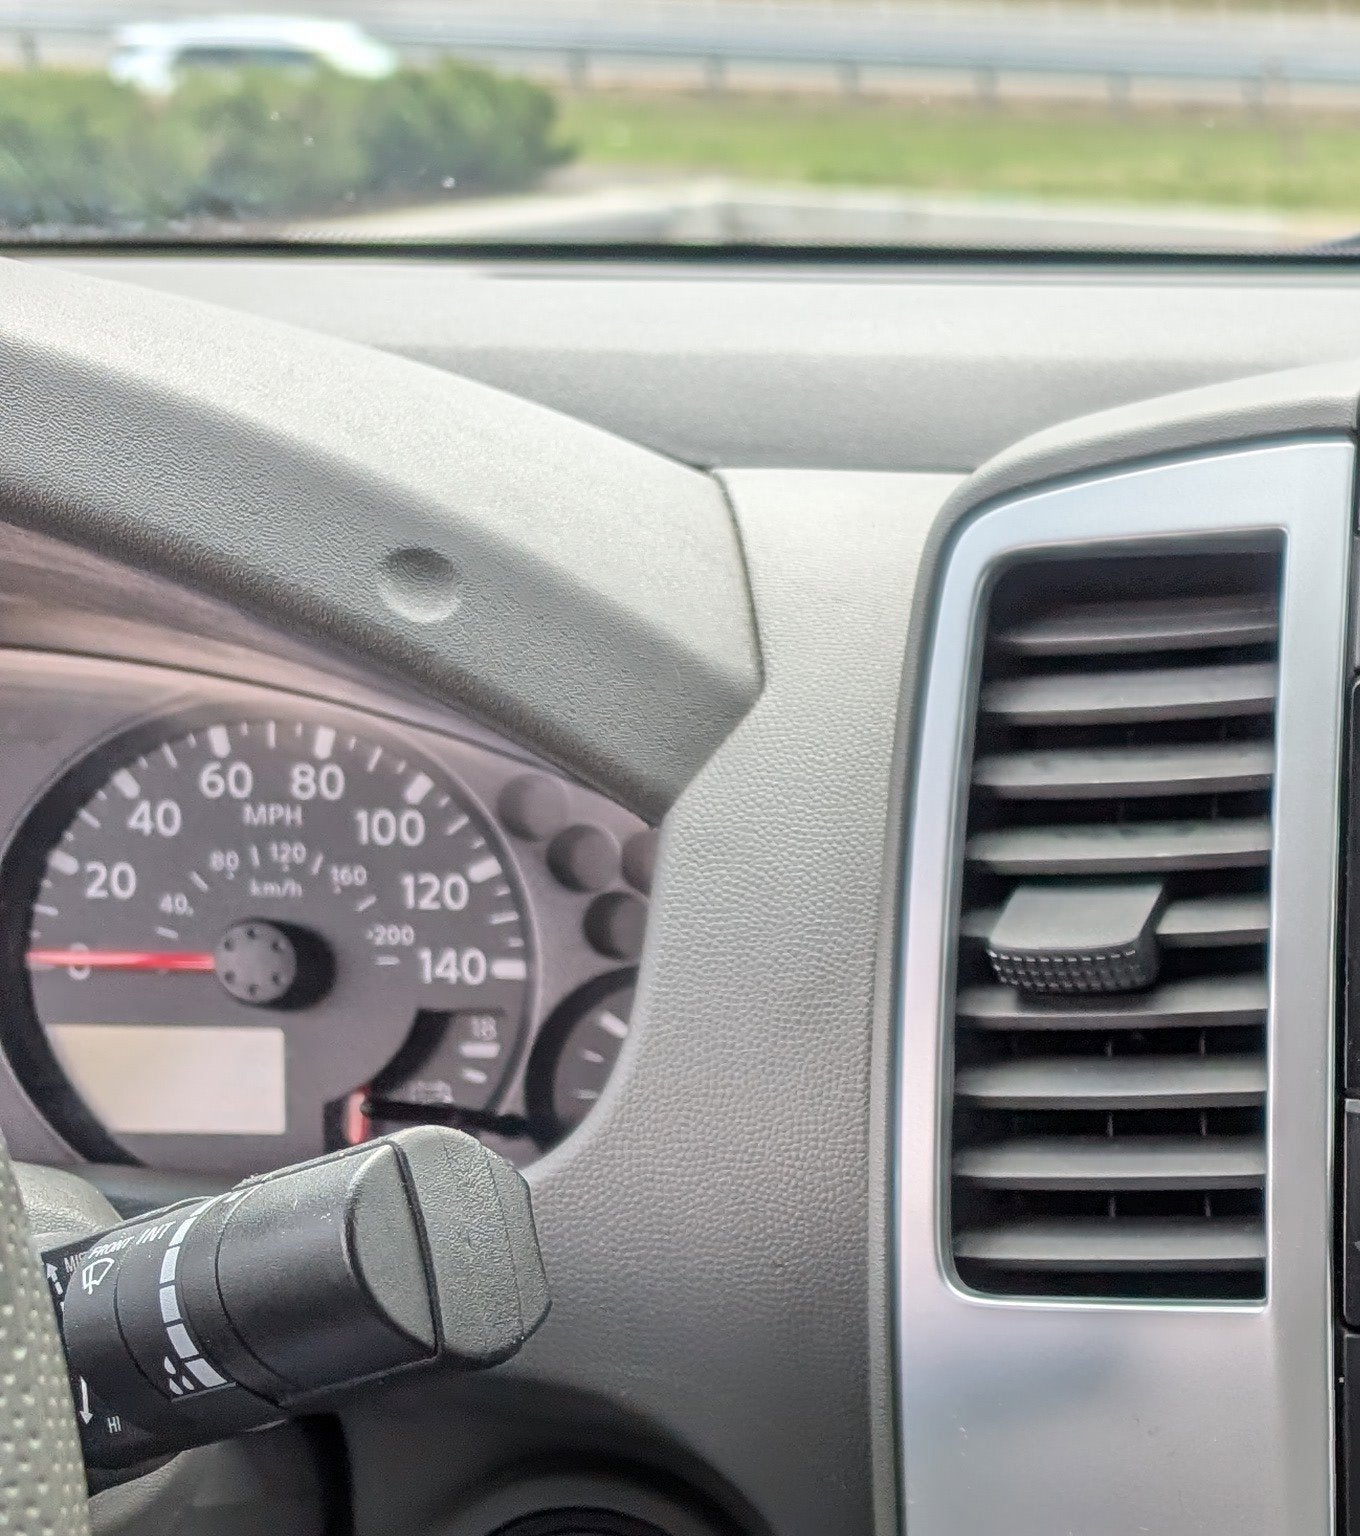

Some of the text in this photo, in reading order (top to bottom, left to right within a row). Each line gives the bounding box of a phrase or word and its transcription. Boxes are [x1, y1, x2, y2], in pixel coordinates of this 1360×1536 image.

[199, 763, 252, 800] 60
[291, 765, 344, 801] 80
[127, 800, 181, 837] 40
[243, 802, 302, 827] MPH
[355, 809, 425, 846] 100
[208, 850, 240, 872] 80
[269, 842, 307, 865] 120
[86, 862, 136, 900] 20
[250, 877, 303, 898] km/h
[330, 864, 367, 886] 160
[159, 892, 187, 914] 40
[402, 872, 469, 911] 120
[373, 924, 415, 946] 200
[418, 946, 487, 985] 140
[88, 1221, 176, 1259] FRONT INT
[106, 1414, 122, 1434] HI
